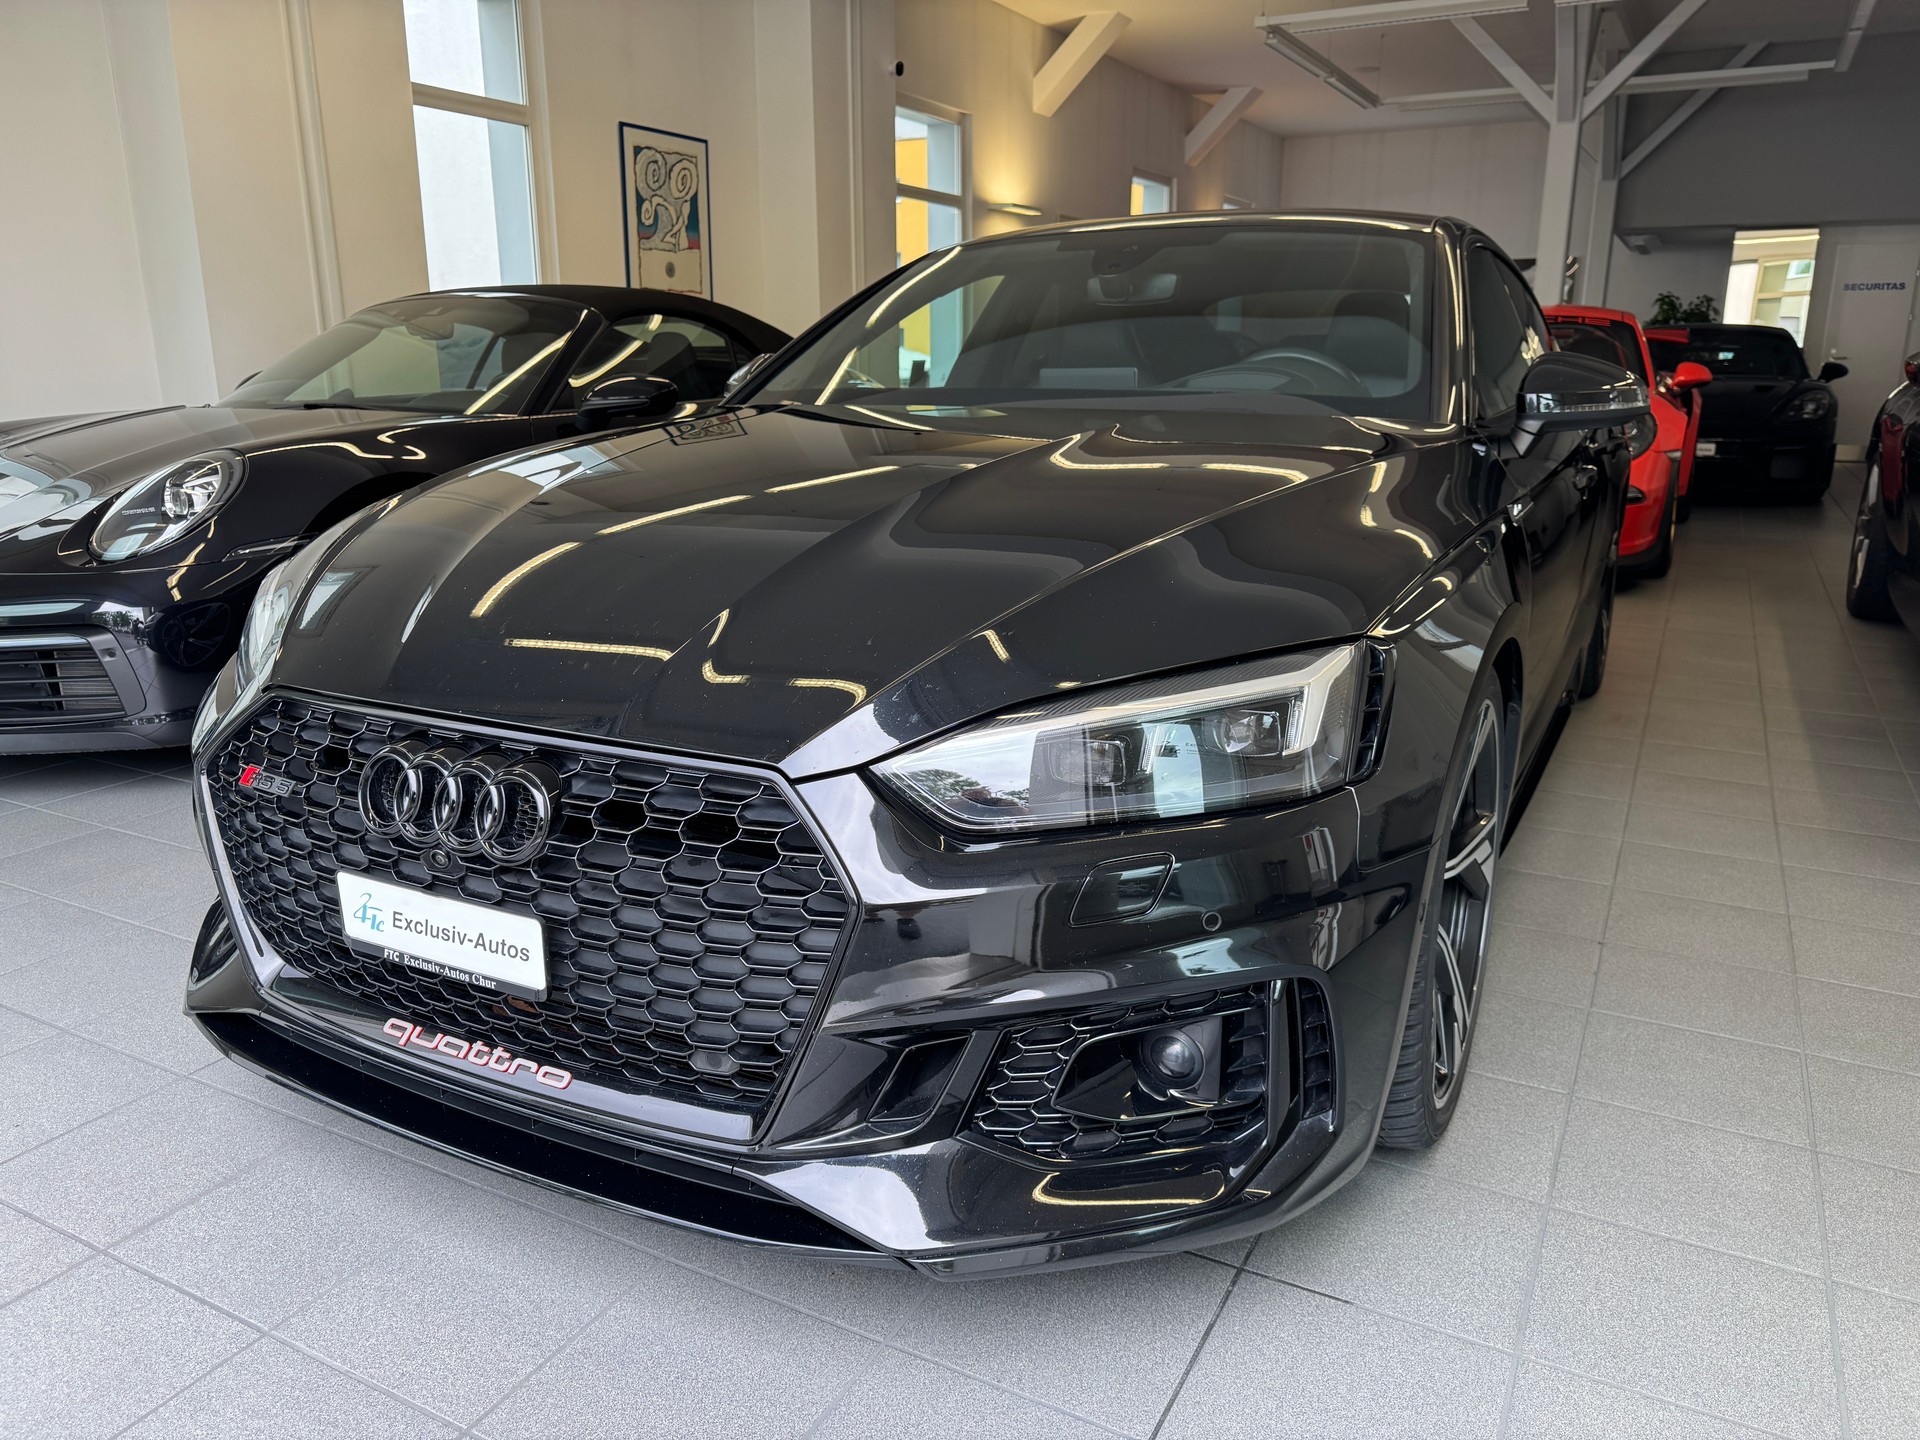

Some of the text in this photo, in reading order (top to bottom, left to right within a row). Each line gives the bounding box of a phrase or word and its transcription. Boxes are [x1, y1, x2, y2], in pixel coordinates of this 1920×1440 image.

[1843, 282, 1906, 291] SECURITAS
[392, 910, 530, 962] Exclusiv-Autos
[384, 948, 496, 989] FTC Exclusiv-Autos Chur
[383, 1017, 573, 1089] quattro
